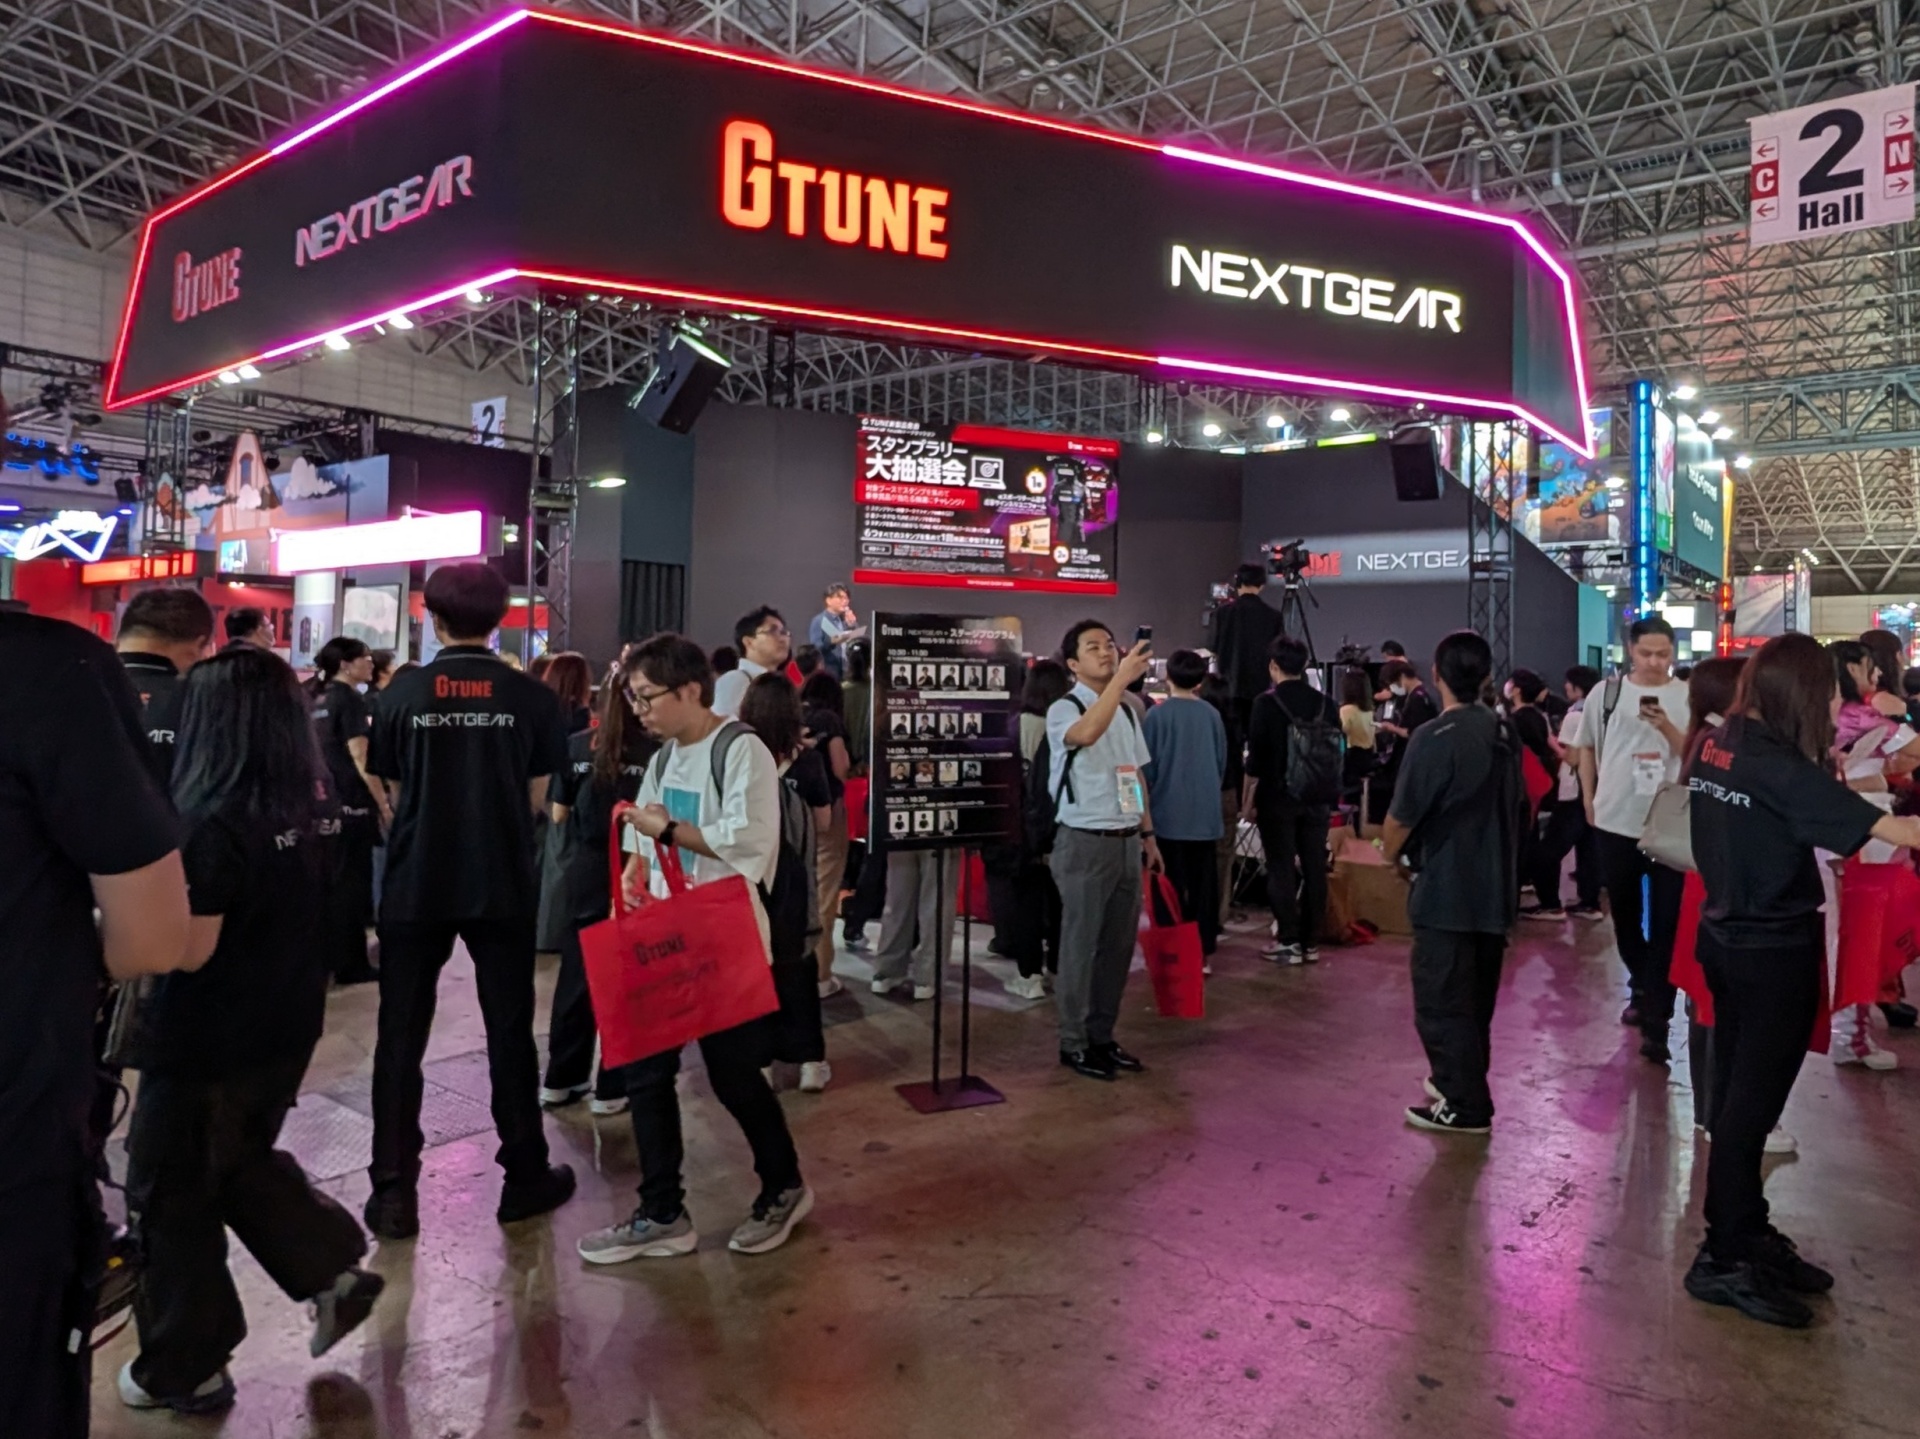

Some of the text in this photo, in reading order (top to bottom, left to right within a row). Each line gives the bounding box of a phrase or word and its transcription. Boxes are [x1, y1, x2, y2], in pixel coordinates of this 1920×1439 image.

[1798, 108, 1864, 197] 2
[1888, 140, 1910, 167] N
[1755, 168, 1775, 193] C
[295, 154, 473, 267] NEXTGEAR
[1798, 192, 1864, 231] Hall
[1170, 244, 1463, 334] NEXTGEAR
[481, 404, 496, 445] 2
[866, 435, 969, 458] スタンプラリー
[865, 453, 967, 487] 大抽選会
[949, 628, 1016, 640] ステージプログラム
[412, 712, 515, 728] NEXTGEAR
